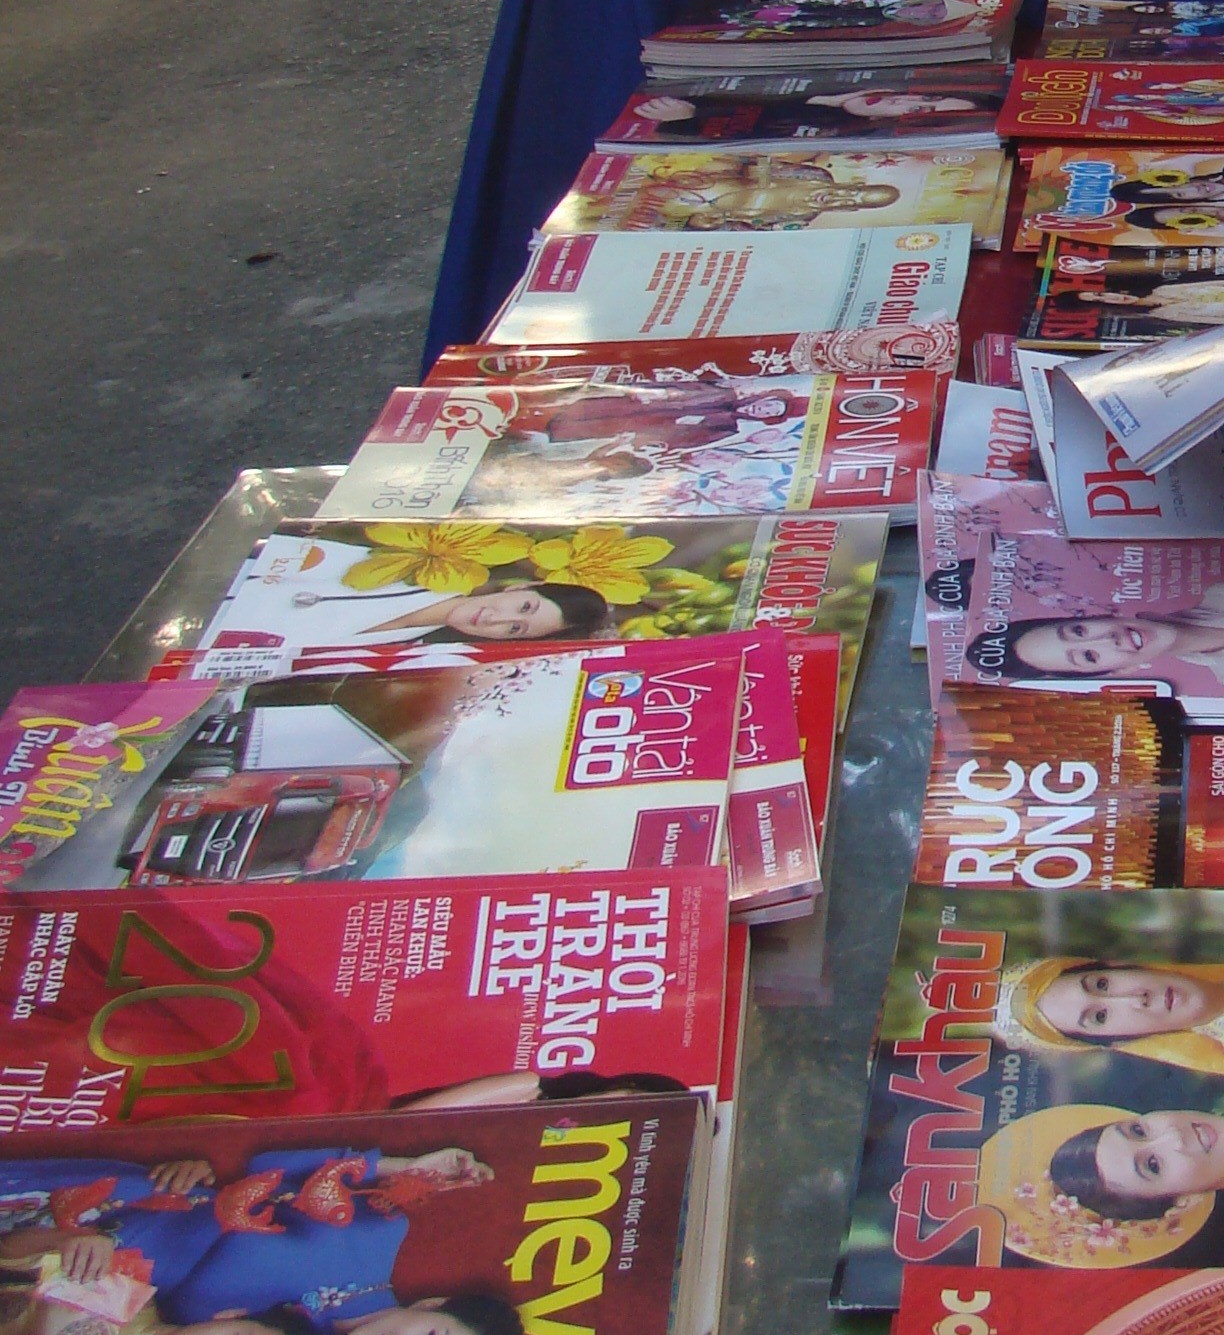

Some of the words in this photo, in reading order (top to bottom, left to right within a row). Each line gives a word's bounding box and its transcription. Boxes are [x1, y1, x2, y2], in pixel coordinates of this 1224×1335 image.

[886, 262, 931, 297] Giáo
[877, 300, 919, 325] chứ
[936, 549, 959, 571] GIA
[756, 556, 837, 609] KHỎE
[930, 574, 962, 602] CỦA
[987, 570, 1016, 605] ĐÌNH
[1111, 578, 1143, 603] Tóc
[984, 608, 1010, 633] GIA
[973, 636, 1008, 668] CỦA
[632, 735, 698, 779] tải
[1209, 780, 1224, 796] SÀI
[943, 759, 1026, 887] RÚC
[1104, 798, 1119, 828] MINH
[1101, 833, 1116, 851] CHÍ
[366, 899, 388, 936] TINH
[387, 899, 409, 944] NHAN
[411, 898, 431, 929] LAN
[432, 897, 454, 931] SIÊU
[29, 912, 56, 957] NHẠC
[54, 912, 79, 955] NGÀY
[485, 892, 552, 996] TRẺ
[605, 887, 677, 1013] THỜI
[41, 958, 68, 1003] XUÂN
[537, 890, 610, 1069] TRANG
[87, 909, 296, 1123] 201
[374, 978, 398, 1022] MANG
[519, 994, 540, 1020] new
[513, 1022, 539, 1070] fashion
[643, 1118, 661, 1132] Vì
[629, 1177, 648, 1195] mà
[622, 1198, 646, 1226] được
[620, 1228, 641, 1253] sinh
[618, 1257, 634, 1270] ra
